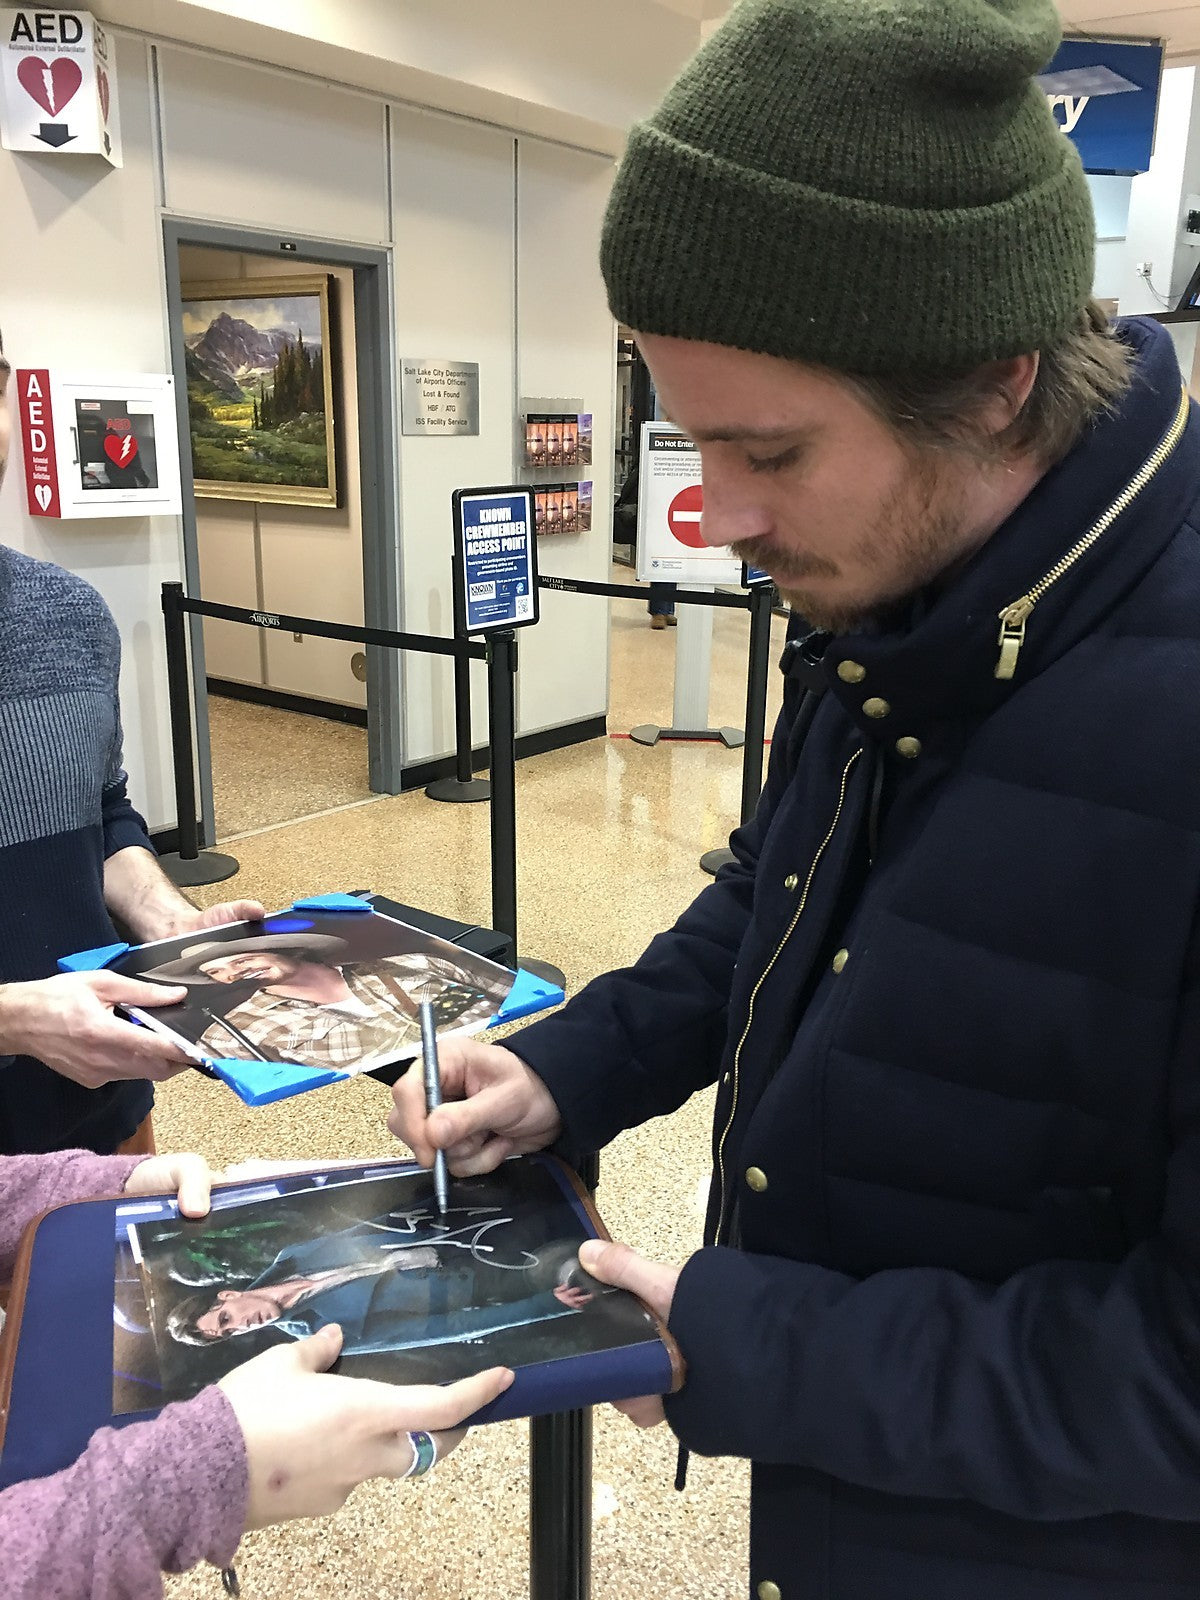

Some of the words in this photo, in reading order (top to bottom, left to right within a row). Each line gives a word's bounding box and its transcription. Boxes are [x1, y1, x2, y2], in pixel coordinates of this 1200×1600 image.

[10, 12, 83, 43] AED
[404, 367, 416, 375] Salt
[417, 368, 431, 376] Lake
[432, 369, 444, 377] City
[445, 369, 477, 378] Department
[423, 377, 445, 385] Airports
[446, 378, 467, 386] Offices
[437, 390, 442, 398] &
[27, 373, 47, 452] AED
[415, 417, 426, 425] ISS
[427, 418, 446, 426] Facility
[479, 507, 512, 524] KNOWN
[465, 521, 526, 541] CREWMEMBER
[466, 538, 501, 556] ACCESS
[501, 536, 526, 552] POINT
